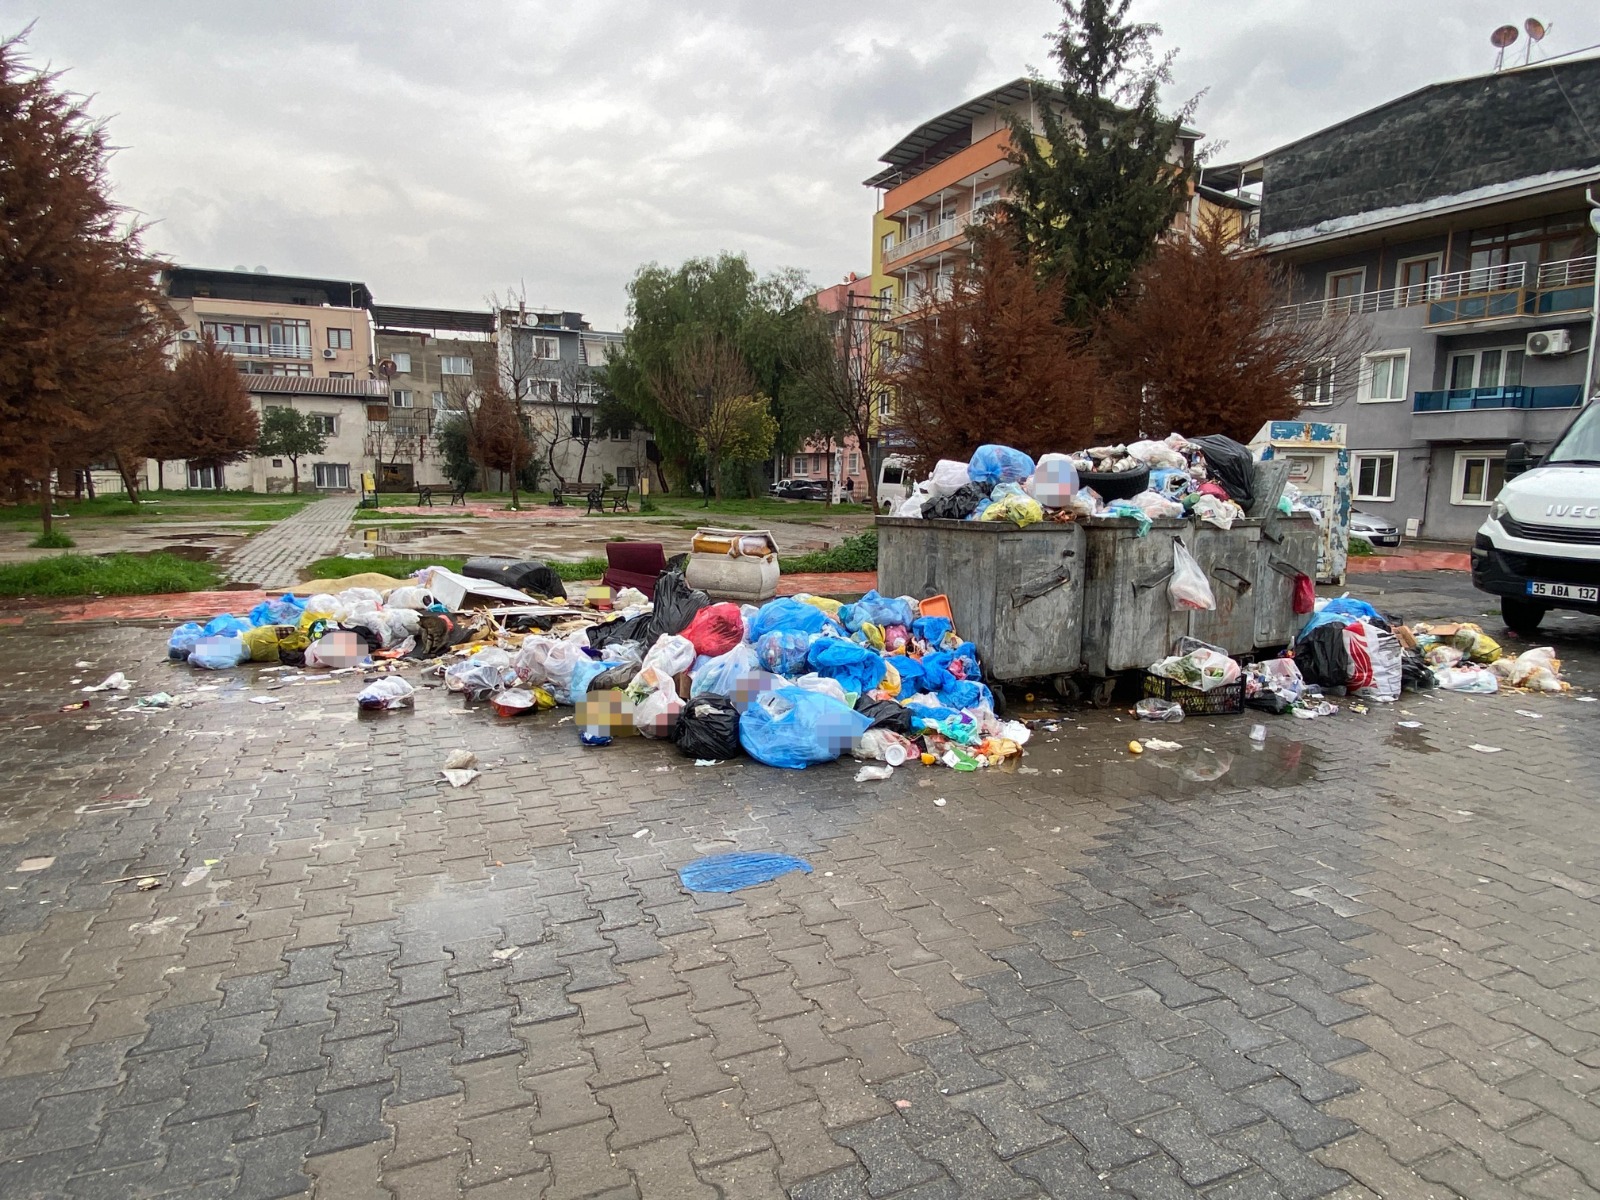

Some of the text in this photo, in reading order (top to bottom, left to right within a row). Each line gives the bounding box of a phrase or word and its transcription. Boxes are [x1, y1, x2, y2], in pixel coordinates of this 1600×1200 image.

[1546, 504, 1600, 518] IVEC
[1533, 583, 1546, 594] 35
[1551, 585, 1569, 597] ABA
[1578, 587, 1596, 599] 132
